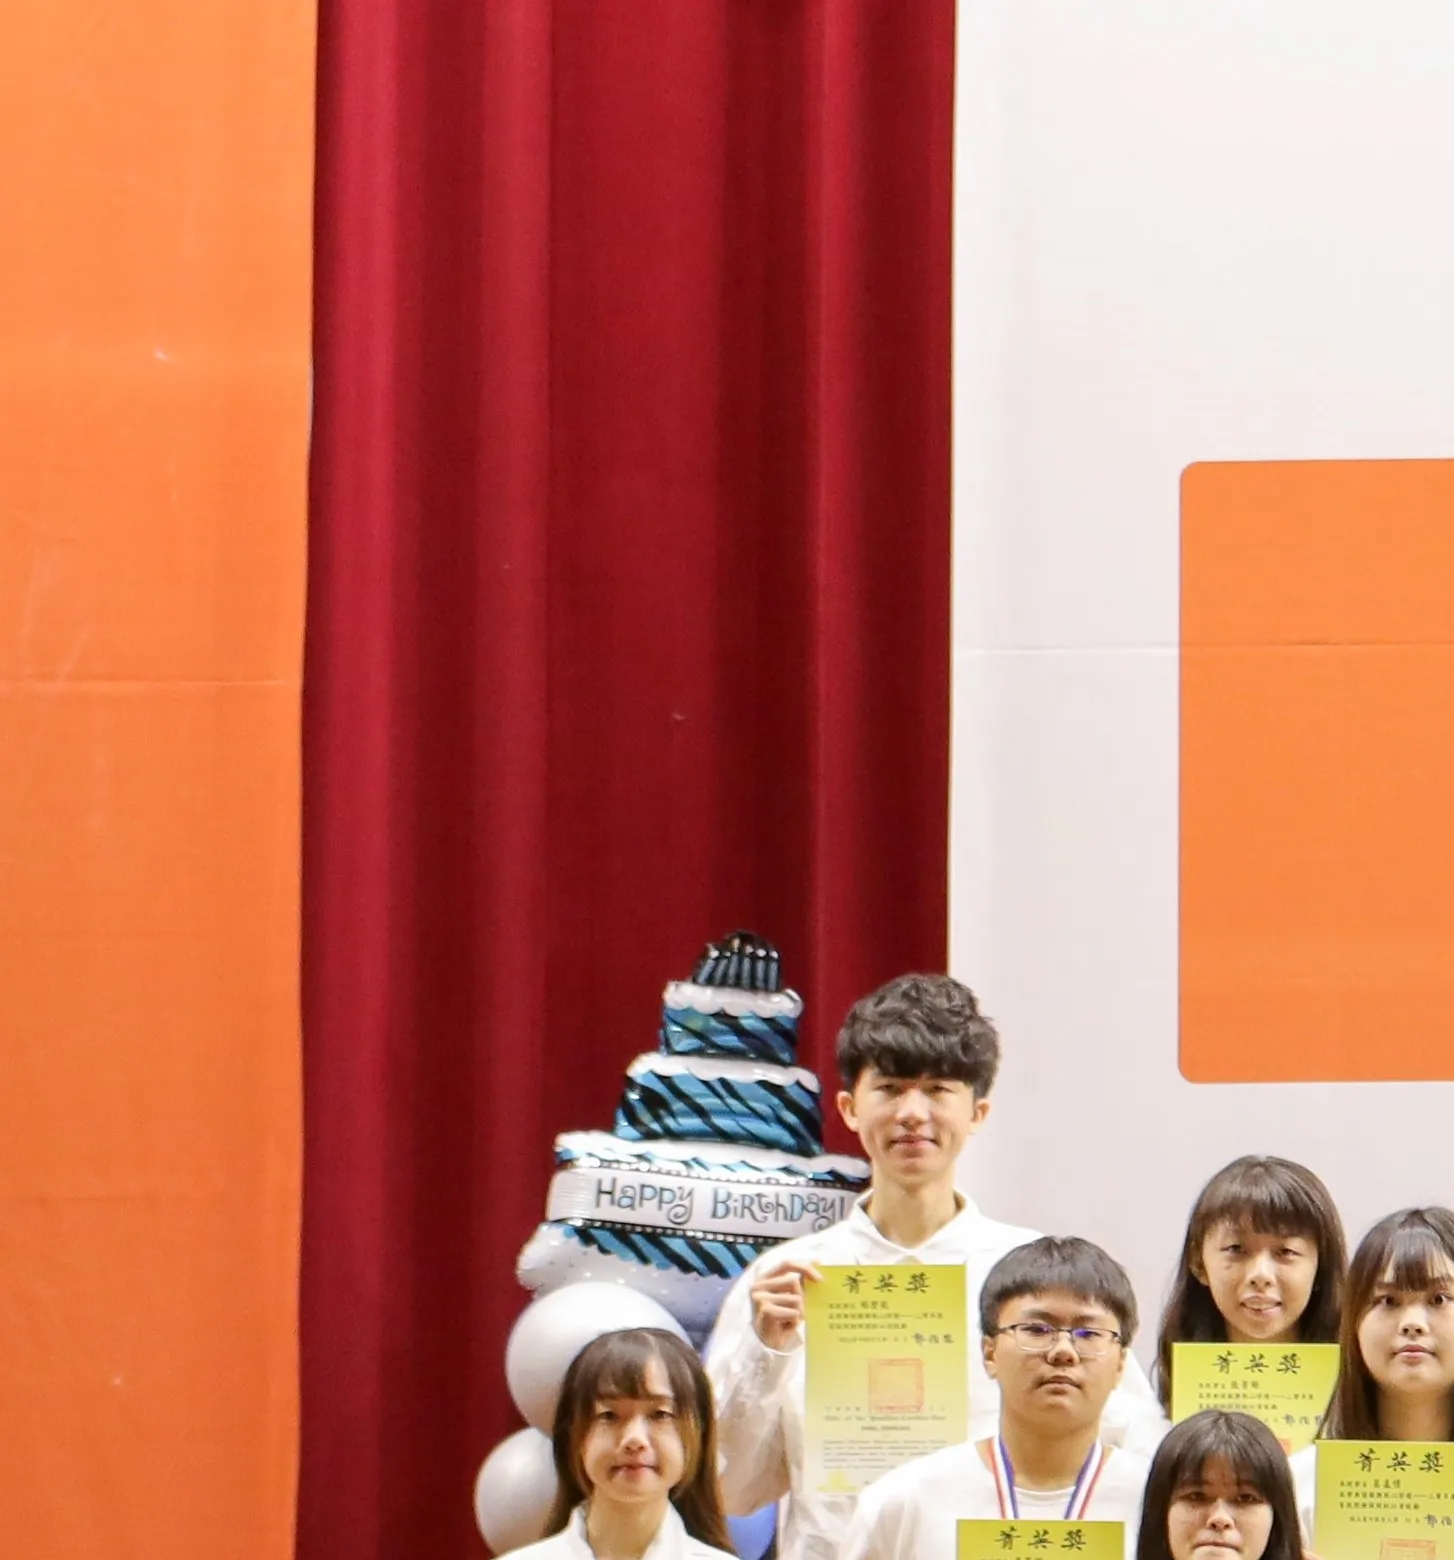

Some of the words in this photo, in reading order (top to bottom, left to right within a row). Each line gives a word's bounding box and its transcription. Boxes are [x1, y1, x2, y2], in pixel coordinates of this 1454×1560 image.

[595, 1177, 695, 1225] Happy
[843, 1271, 930, 1294] 菁英獎
[1212, 1350, 1300, 1375] 菁英獎
[1355, 1448, 1444, 1473] 菁英獎
[995, 1525, 1087, 1551] 菁英獎
